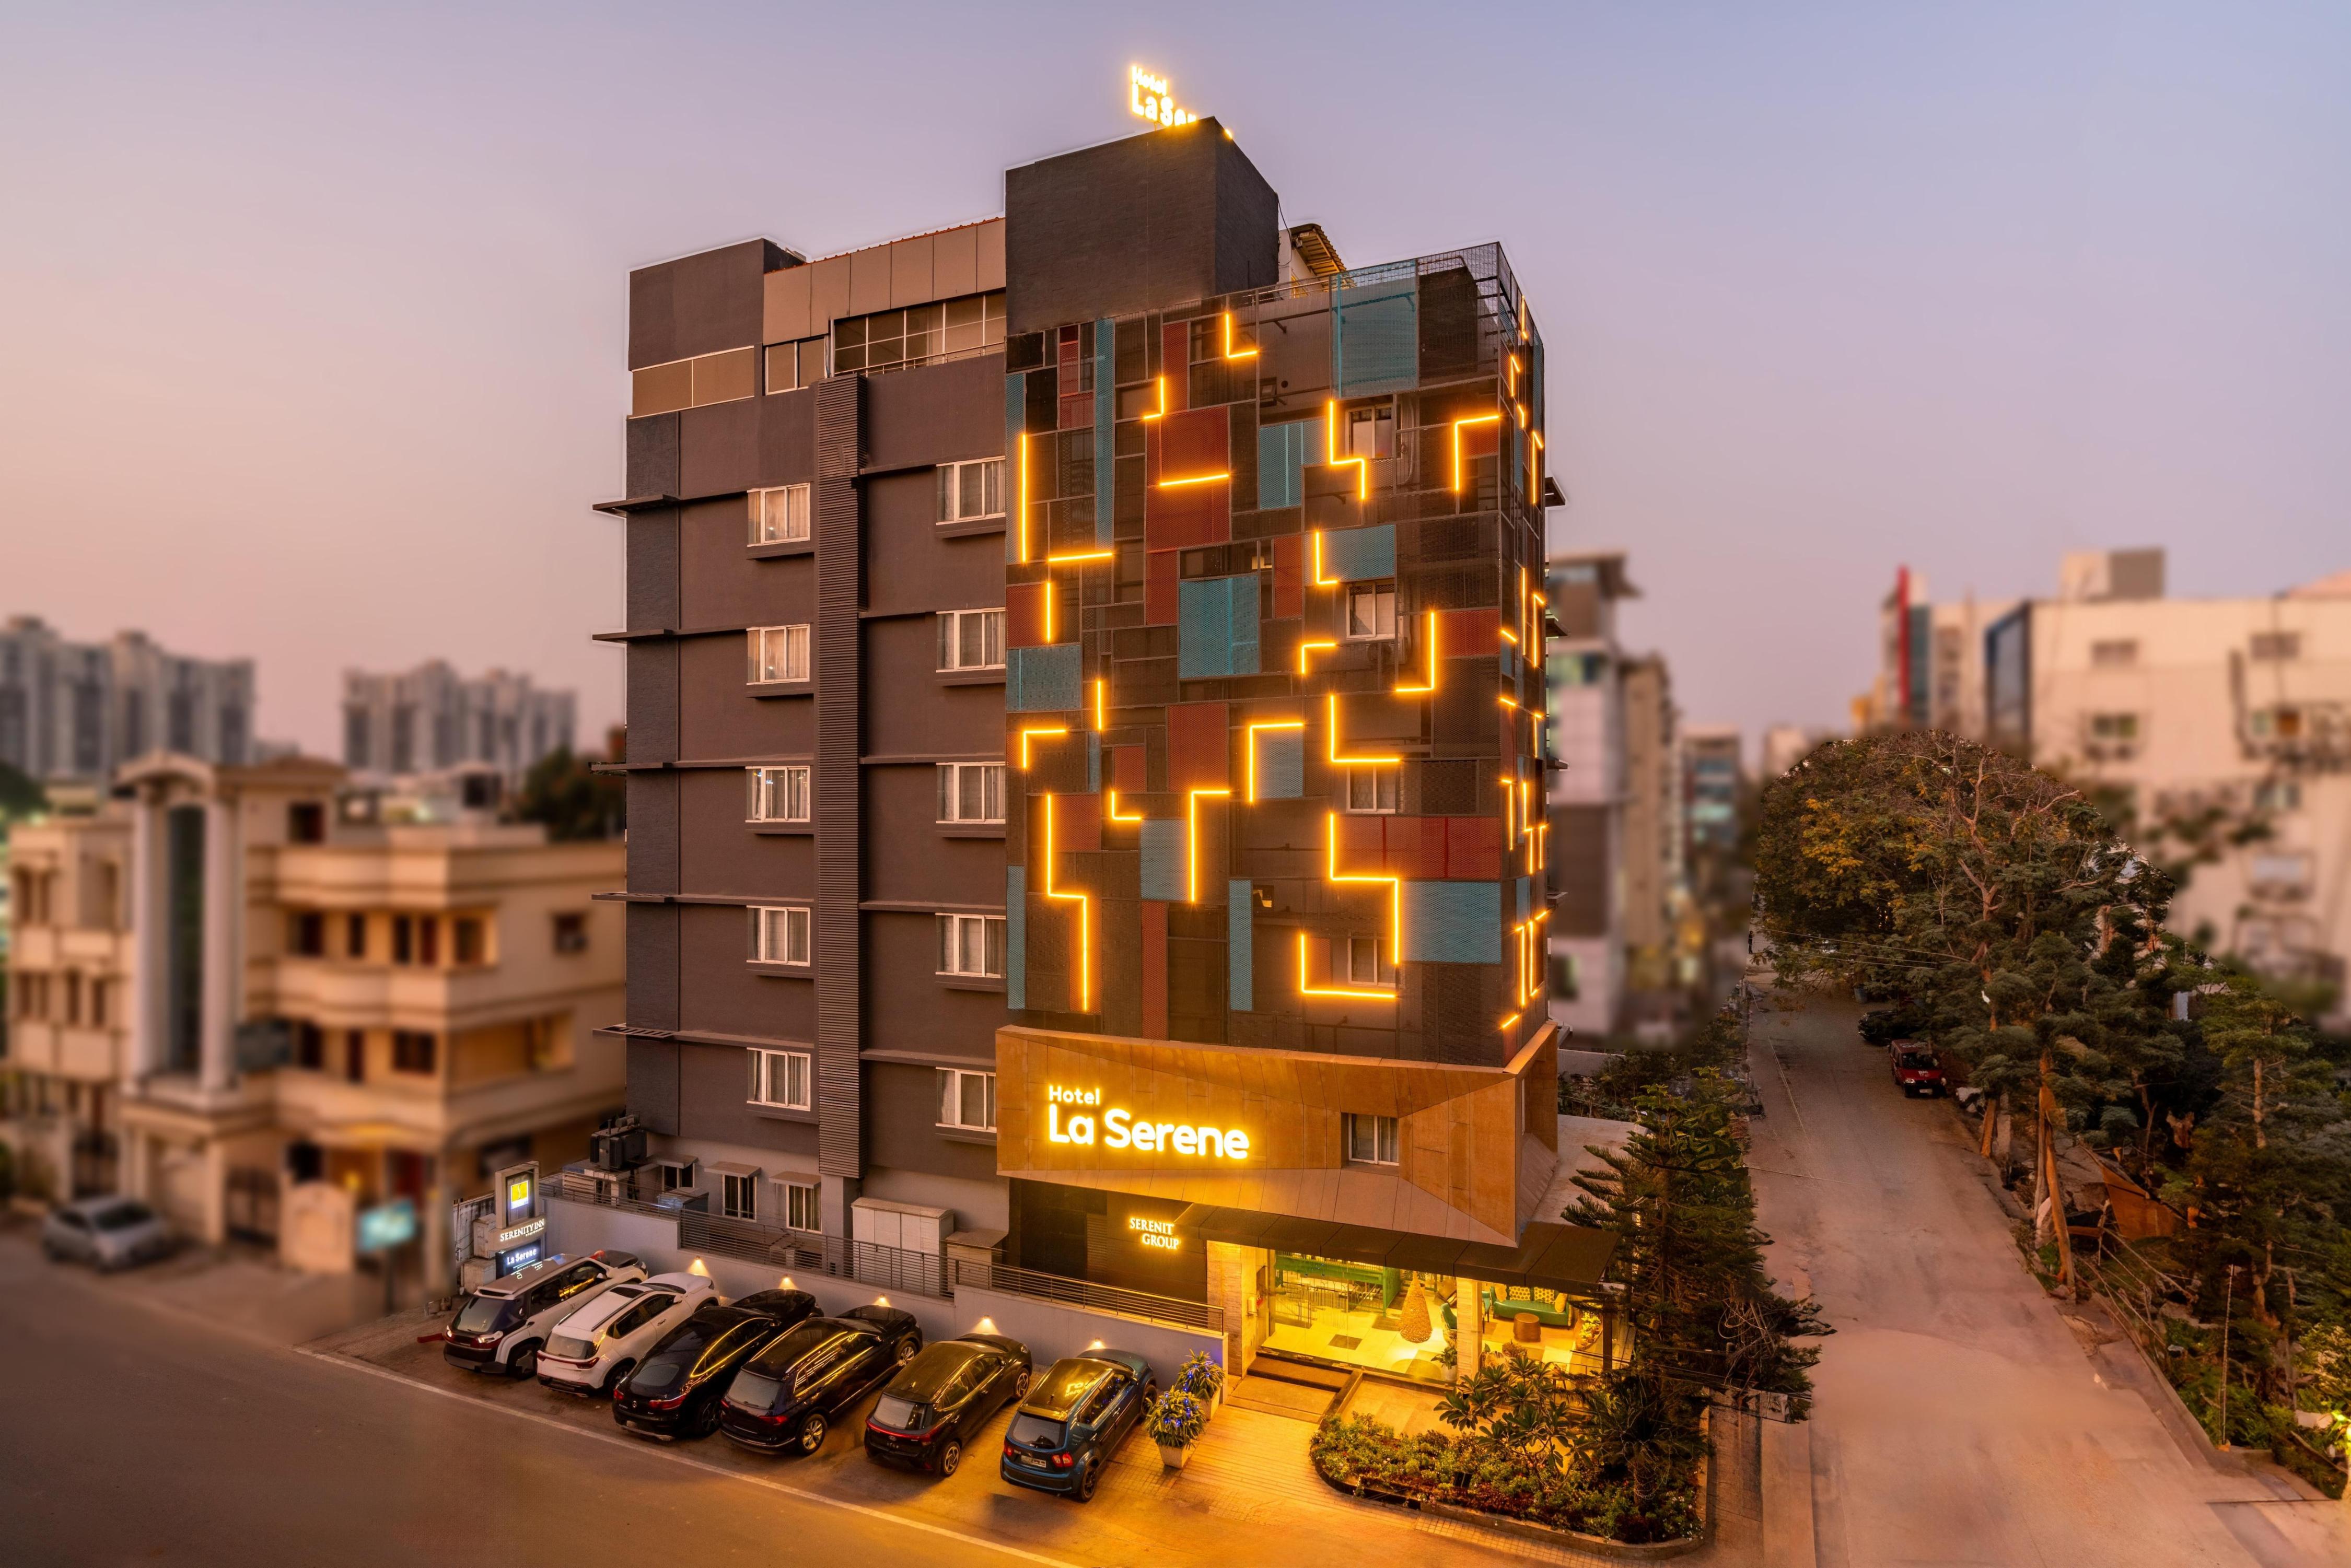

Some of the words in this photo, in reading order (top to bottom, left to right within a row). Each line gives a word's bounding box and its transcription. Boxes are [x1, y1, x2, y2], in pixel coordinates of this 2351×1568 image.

[1132, 66, 1167, 96] Hotel
[1132, 83, 1158, 121] La
[1049, 1085, 1100, 1105] Hotel
[1049, 1104, 1094, 1145] La
[1104, 1108, 1250, 1159] Serene
[500, 1223, 534, 1242] SERENITY
[534, 1219, 544, 1230] INN
[1142, 1233, 1180, 1249] GROUP
[507, 1257, 515, 1265] La
[516, 1249, 537, 1261] Serene
